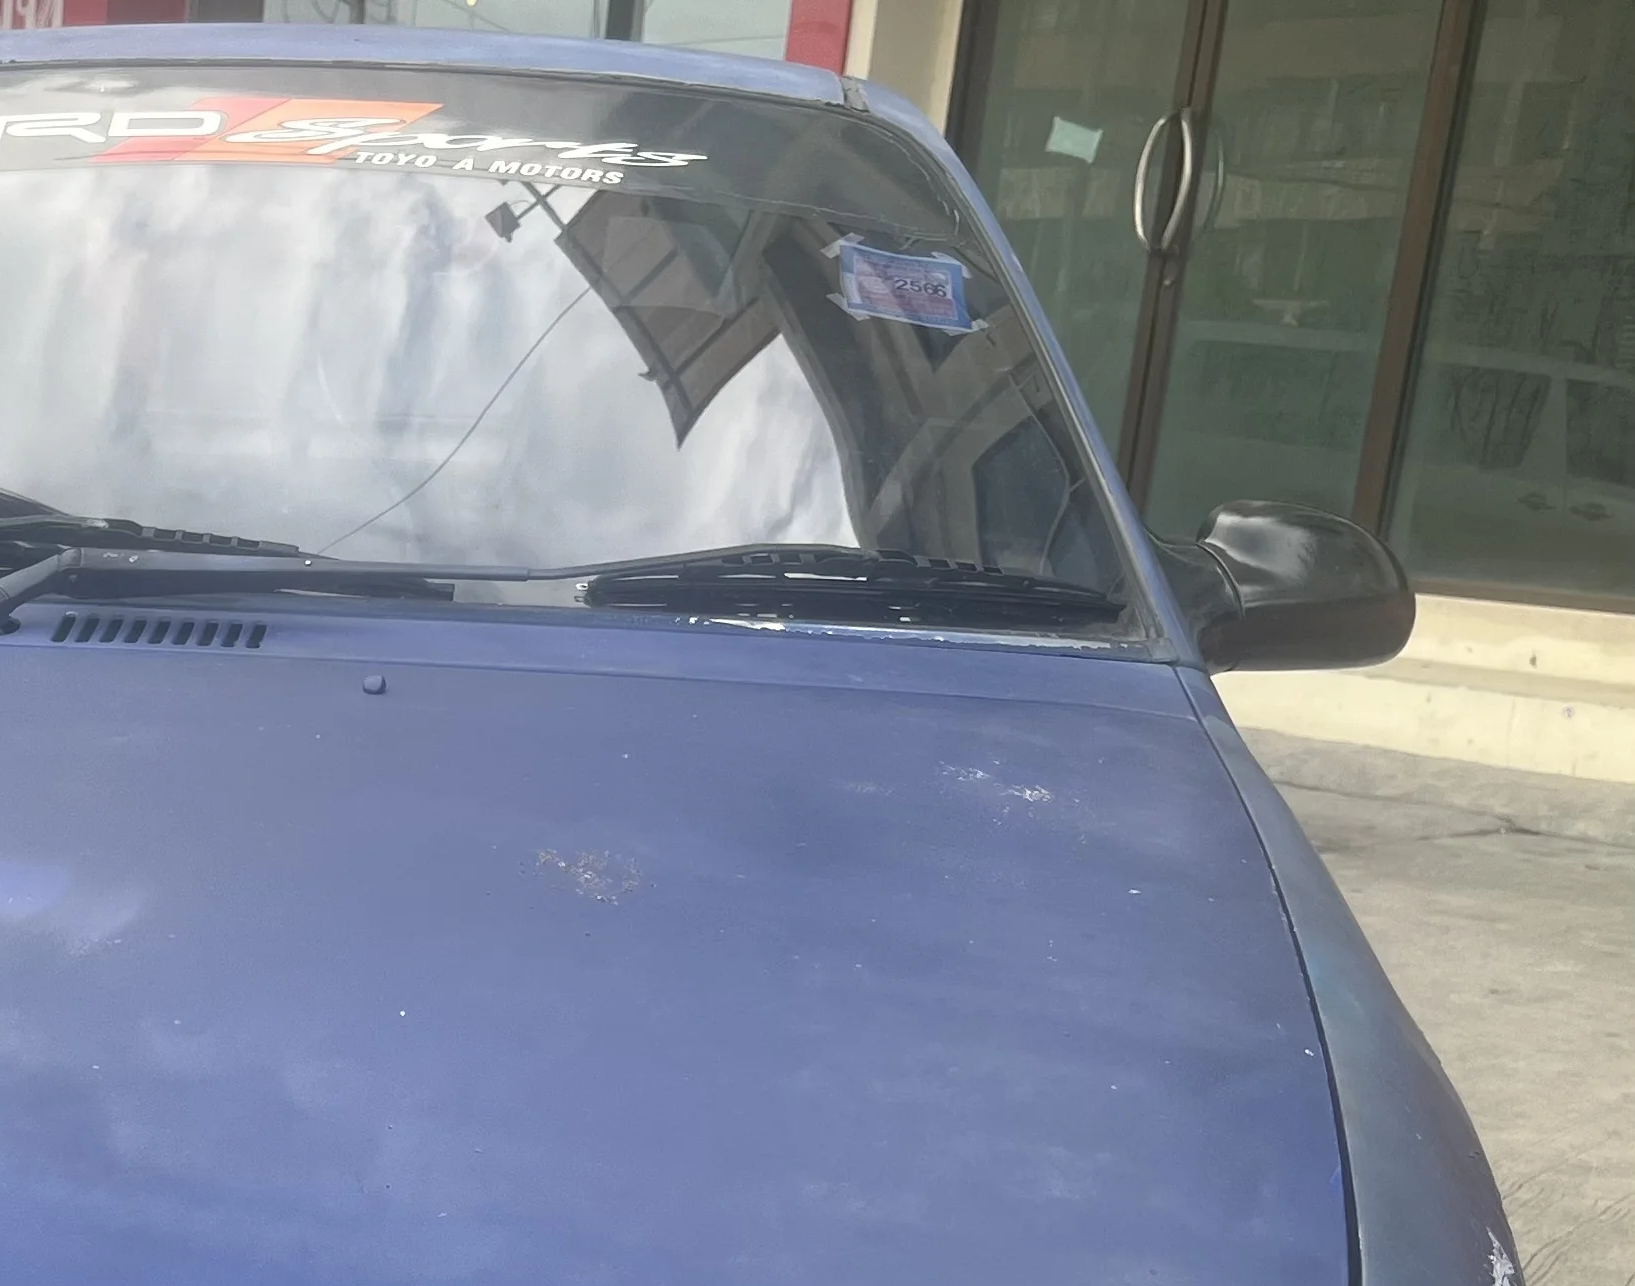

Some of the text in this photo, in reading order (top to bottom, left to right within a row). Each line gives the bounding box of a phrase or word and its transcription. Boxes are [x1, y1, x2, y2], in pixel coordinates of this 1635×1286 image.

[226, 117, 707, 166] Sports
[354, 151, 437, 169] TOYO
[488, 160, 624, 185] MOTORS
[894, 279, 946, 298] 2566
